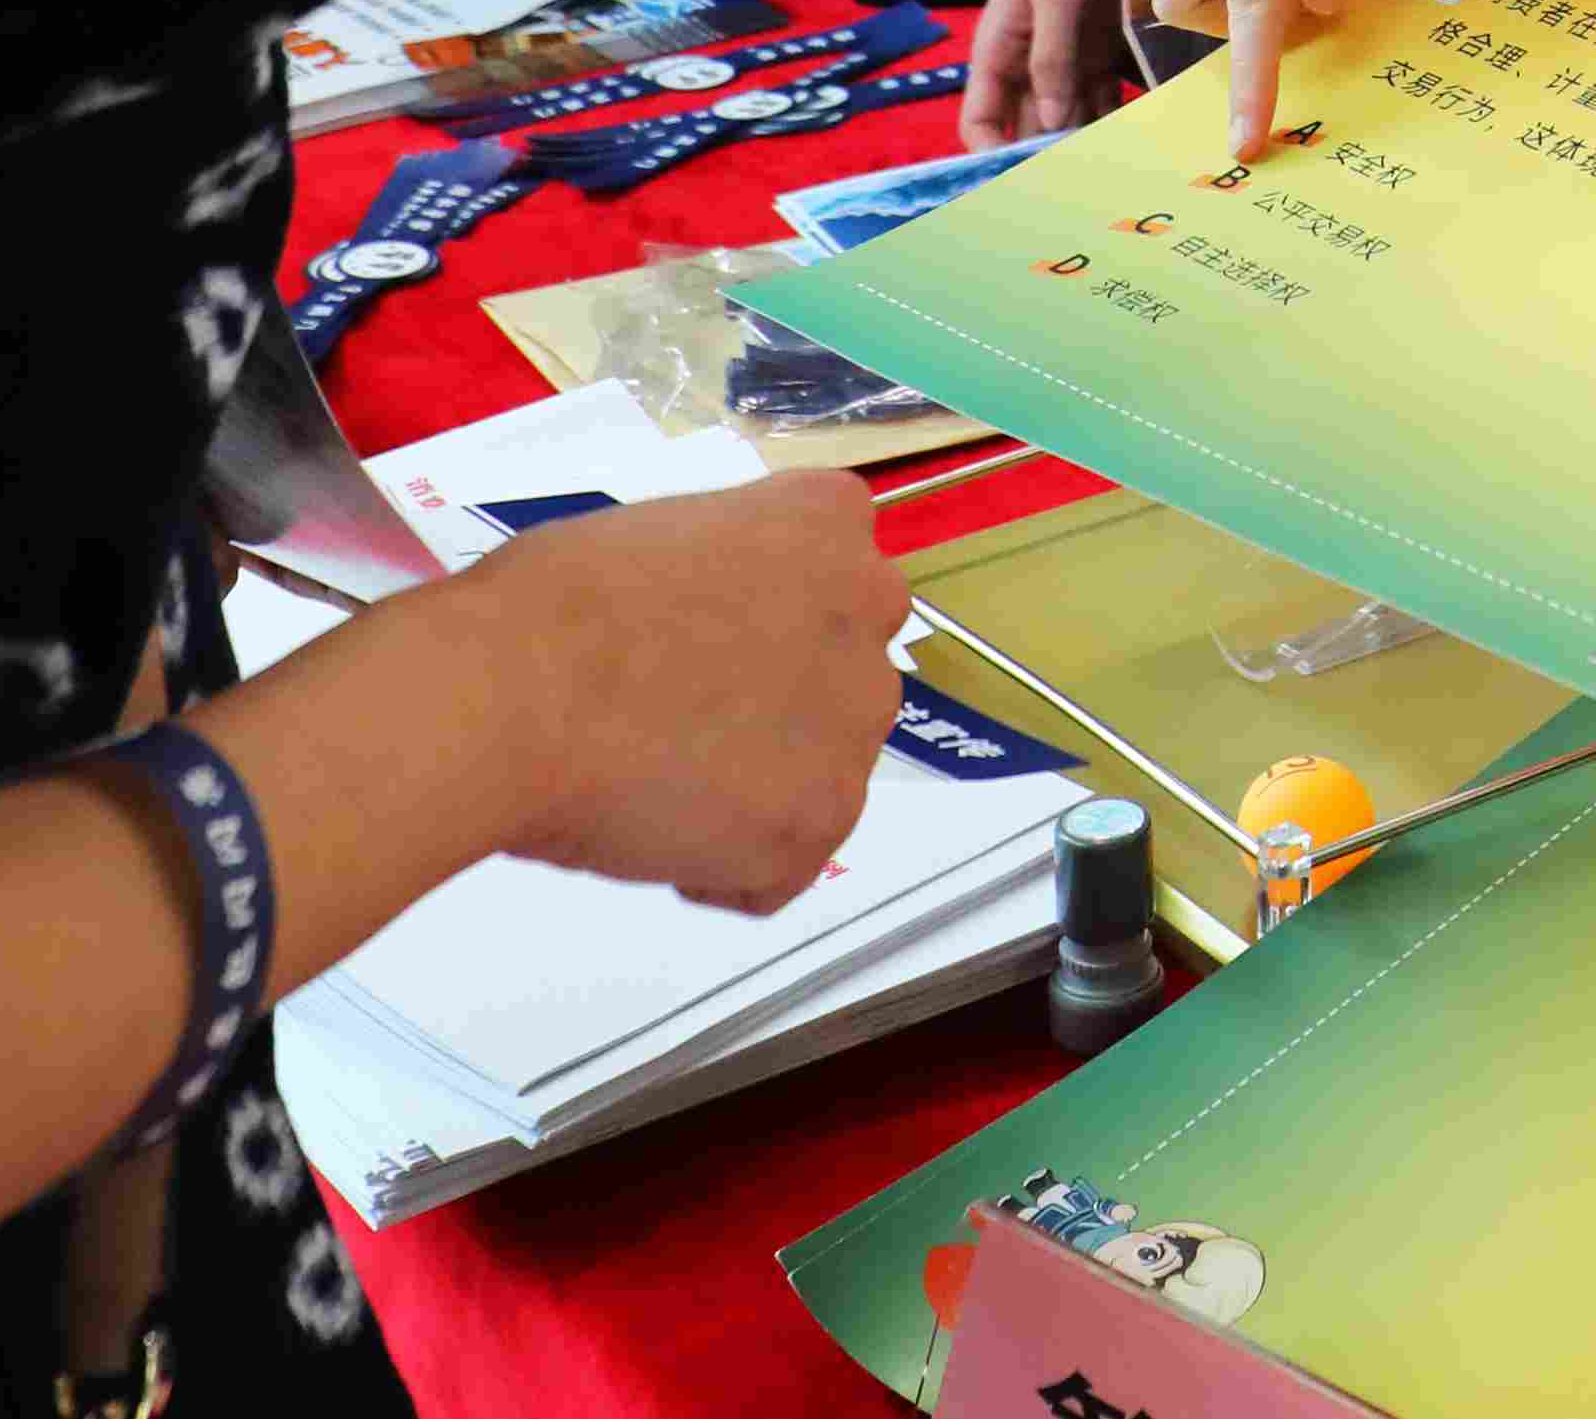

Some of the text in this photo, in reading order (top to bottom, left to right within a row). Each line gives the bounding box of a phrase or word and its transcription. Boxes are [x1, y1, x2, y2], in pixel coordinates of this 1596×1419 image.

[1288, 119, 1419, 190] A 安全权
[1208, 165, 1393, 263] B 公平交易权
[1049, 253, 1182, 325] D 求偿权
[1134, 212, 1314, 307] C 自主选择权
